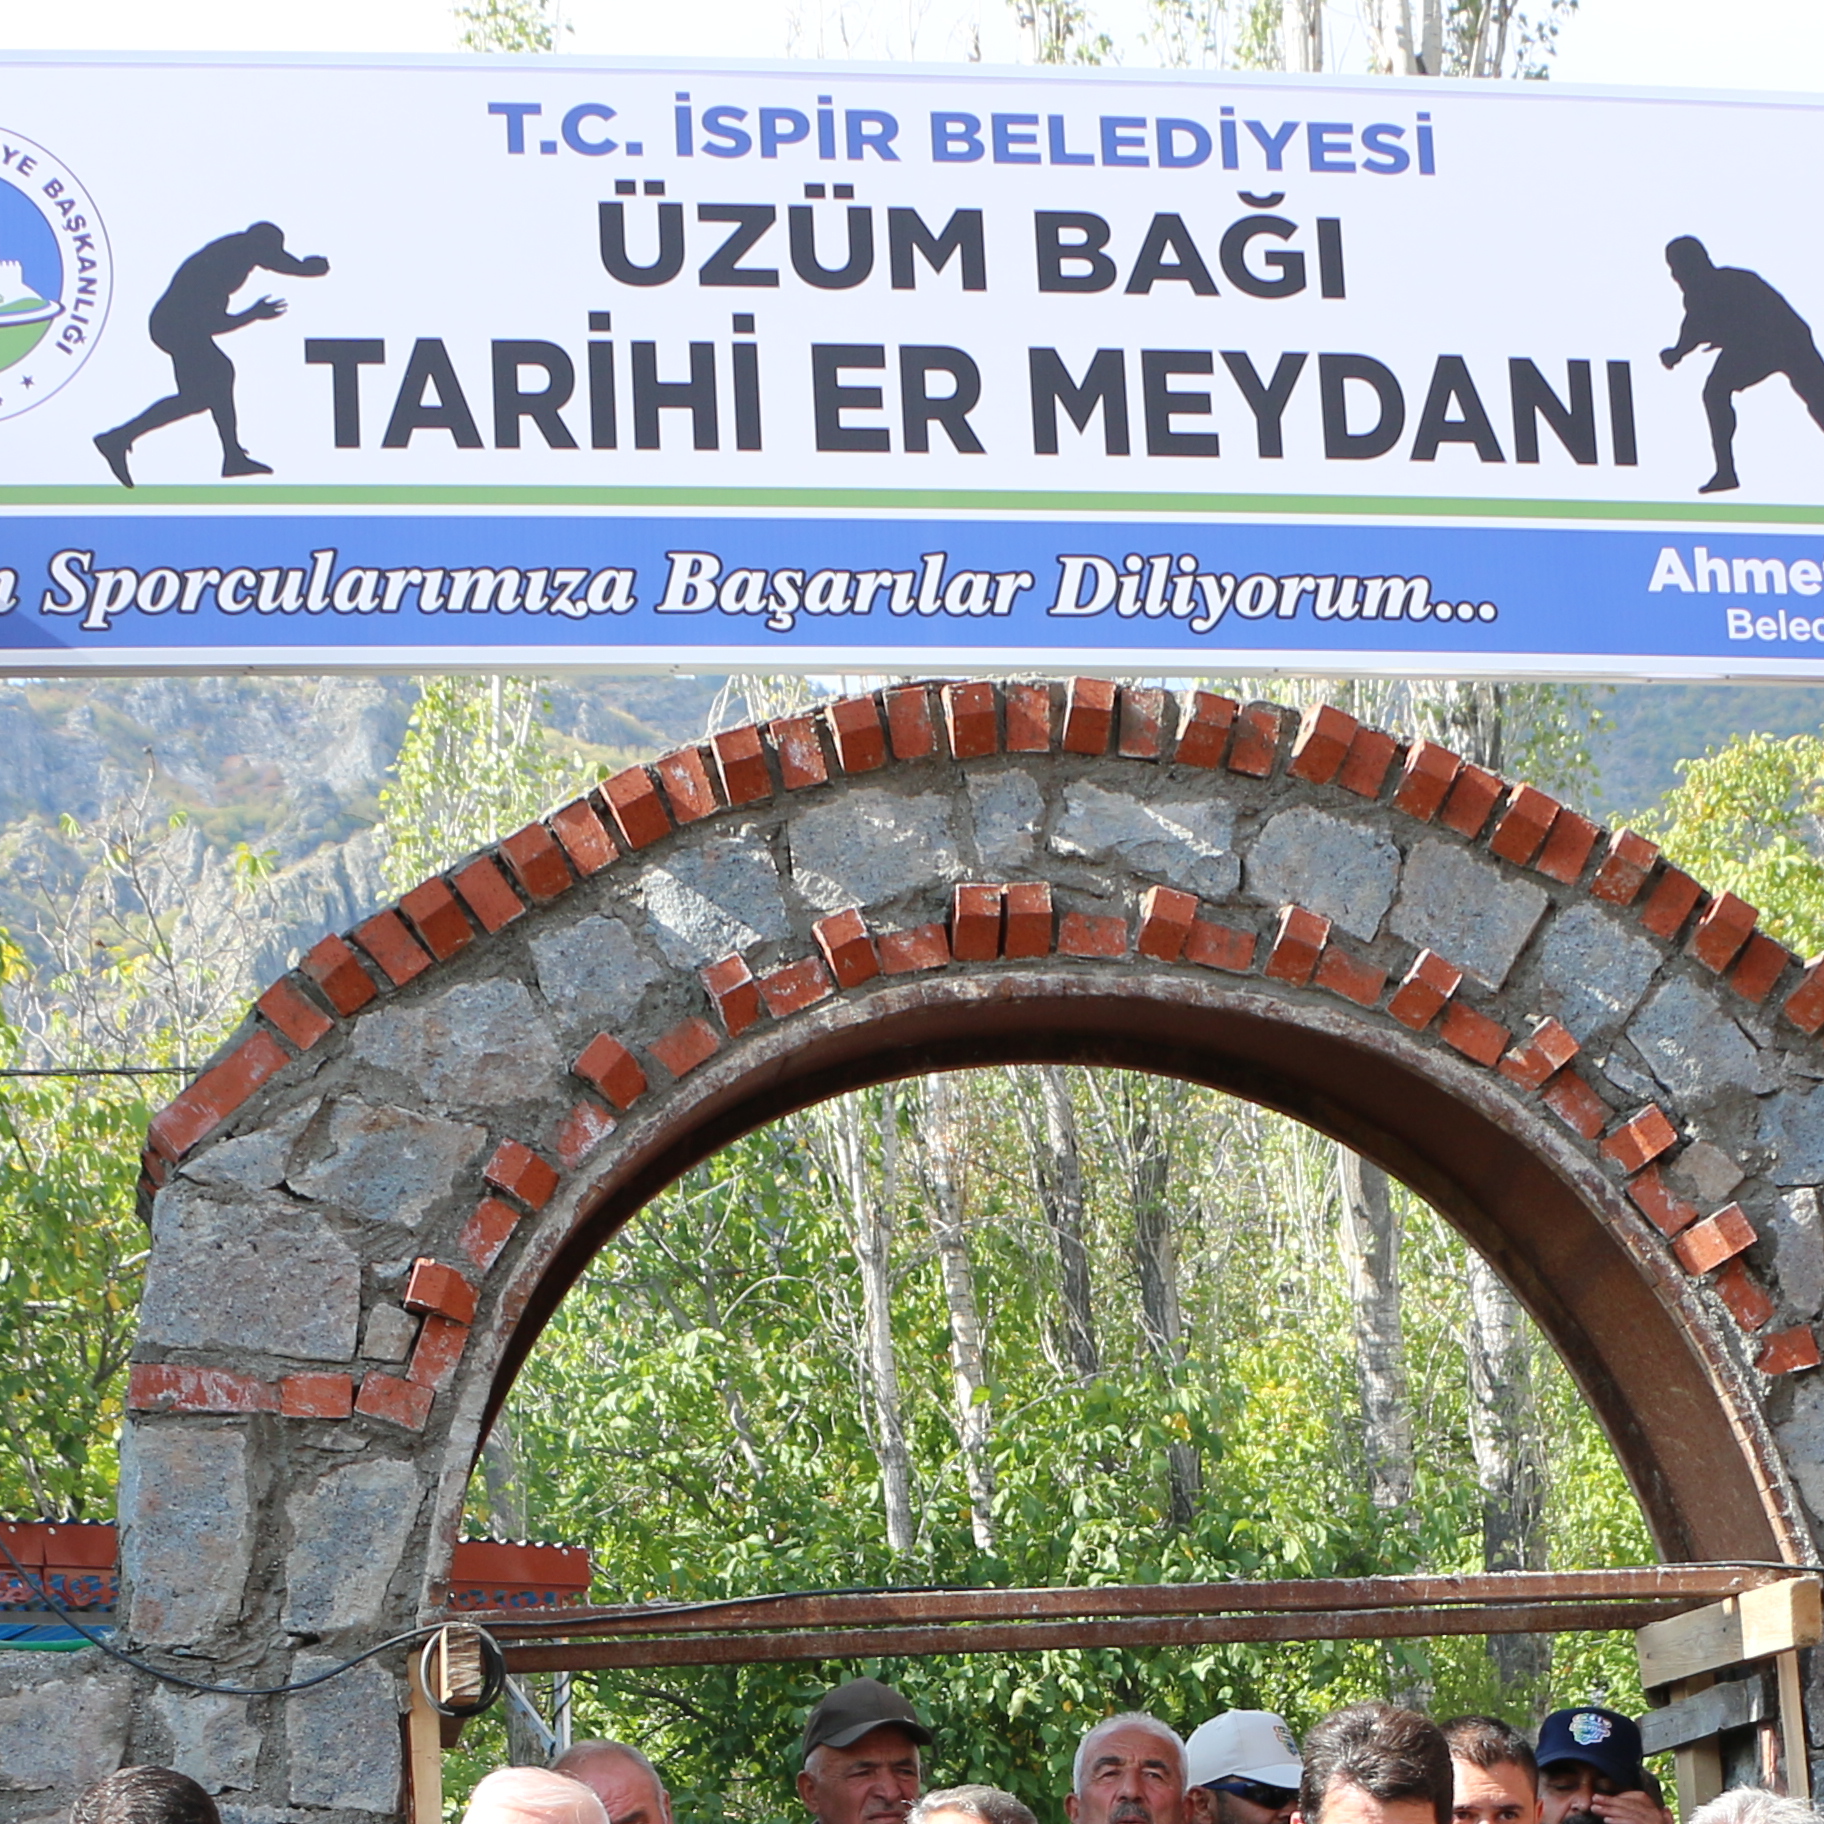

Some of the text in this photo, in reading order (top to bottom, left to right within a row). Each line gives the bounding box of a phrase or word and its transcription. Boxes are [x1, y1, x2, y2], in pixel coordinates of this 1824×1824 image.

[488, 93, 1435, 175] T.C. İSPİR BELEDİYESİ
[41, 177, 98, 356] BAŞKANLIĞI
[599, 180, 1345, 298] ÜZÜM BAĞI
[305, 312, 1637, 466] TARİHİ ER MEYDANI
[40, 548, 637, 632] Sporcularımıza
[654, 551, 1035, 633] Başarılar
[1047, 553, 1498, 635] Diliyorum...
